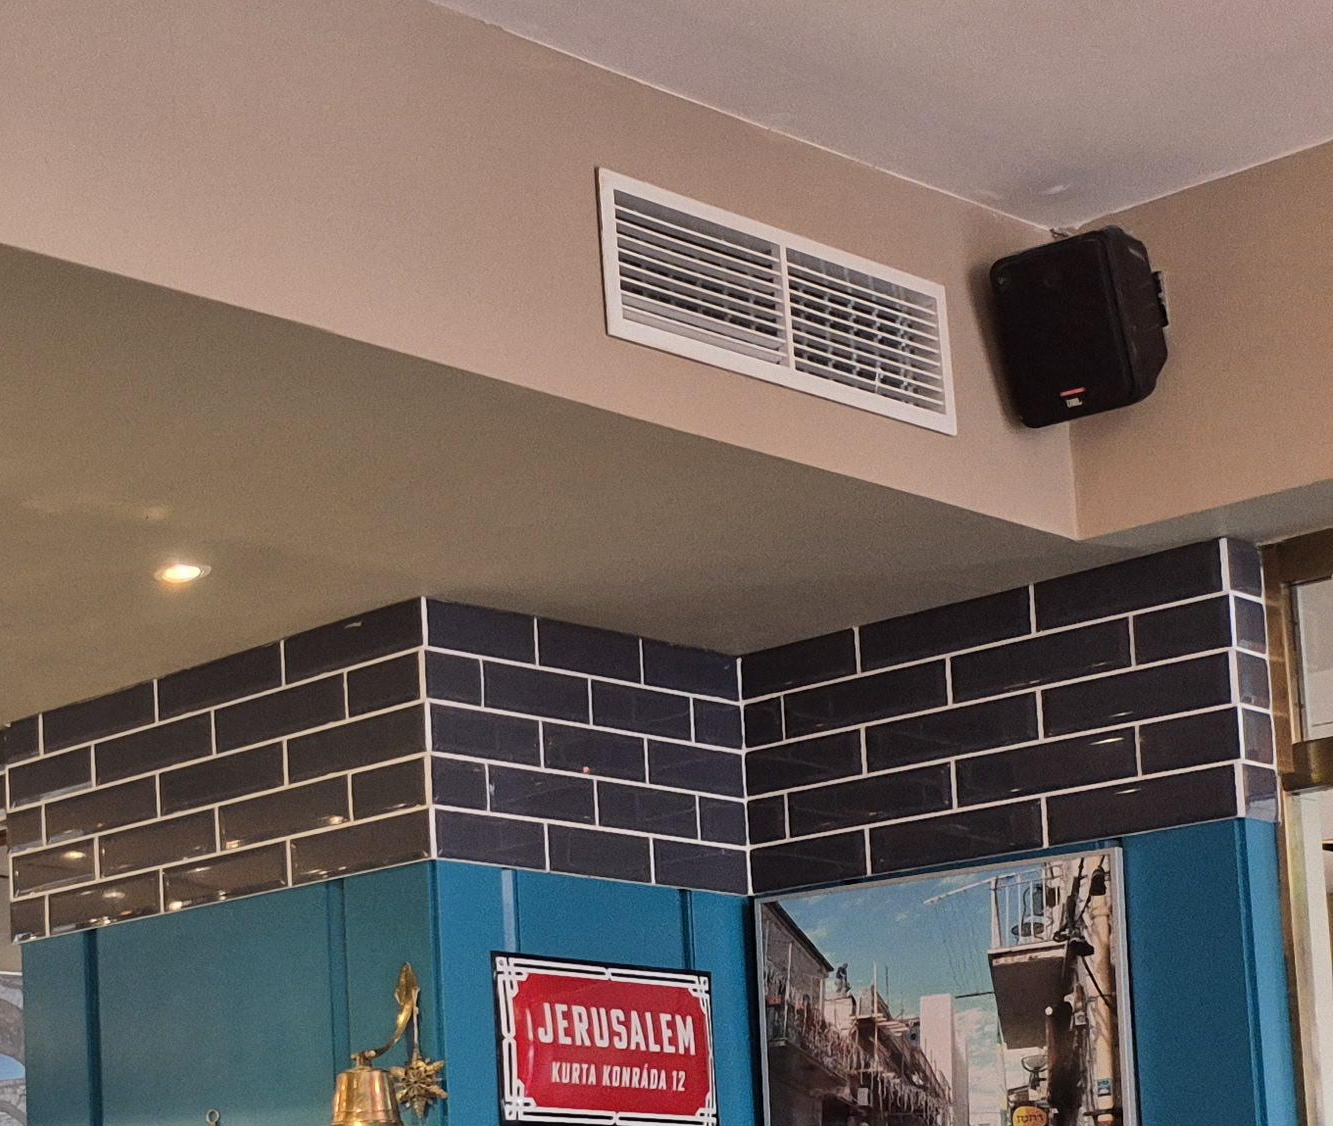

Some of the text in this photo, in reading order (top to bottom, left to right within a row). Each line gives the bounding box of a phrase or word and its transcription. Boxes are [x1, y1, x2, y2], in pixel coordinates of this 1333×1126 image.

[538, 1002, 696, 1056] JERUSALEM
[552, 1061, 686, 1092] KURTA KONRÁDA 12
